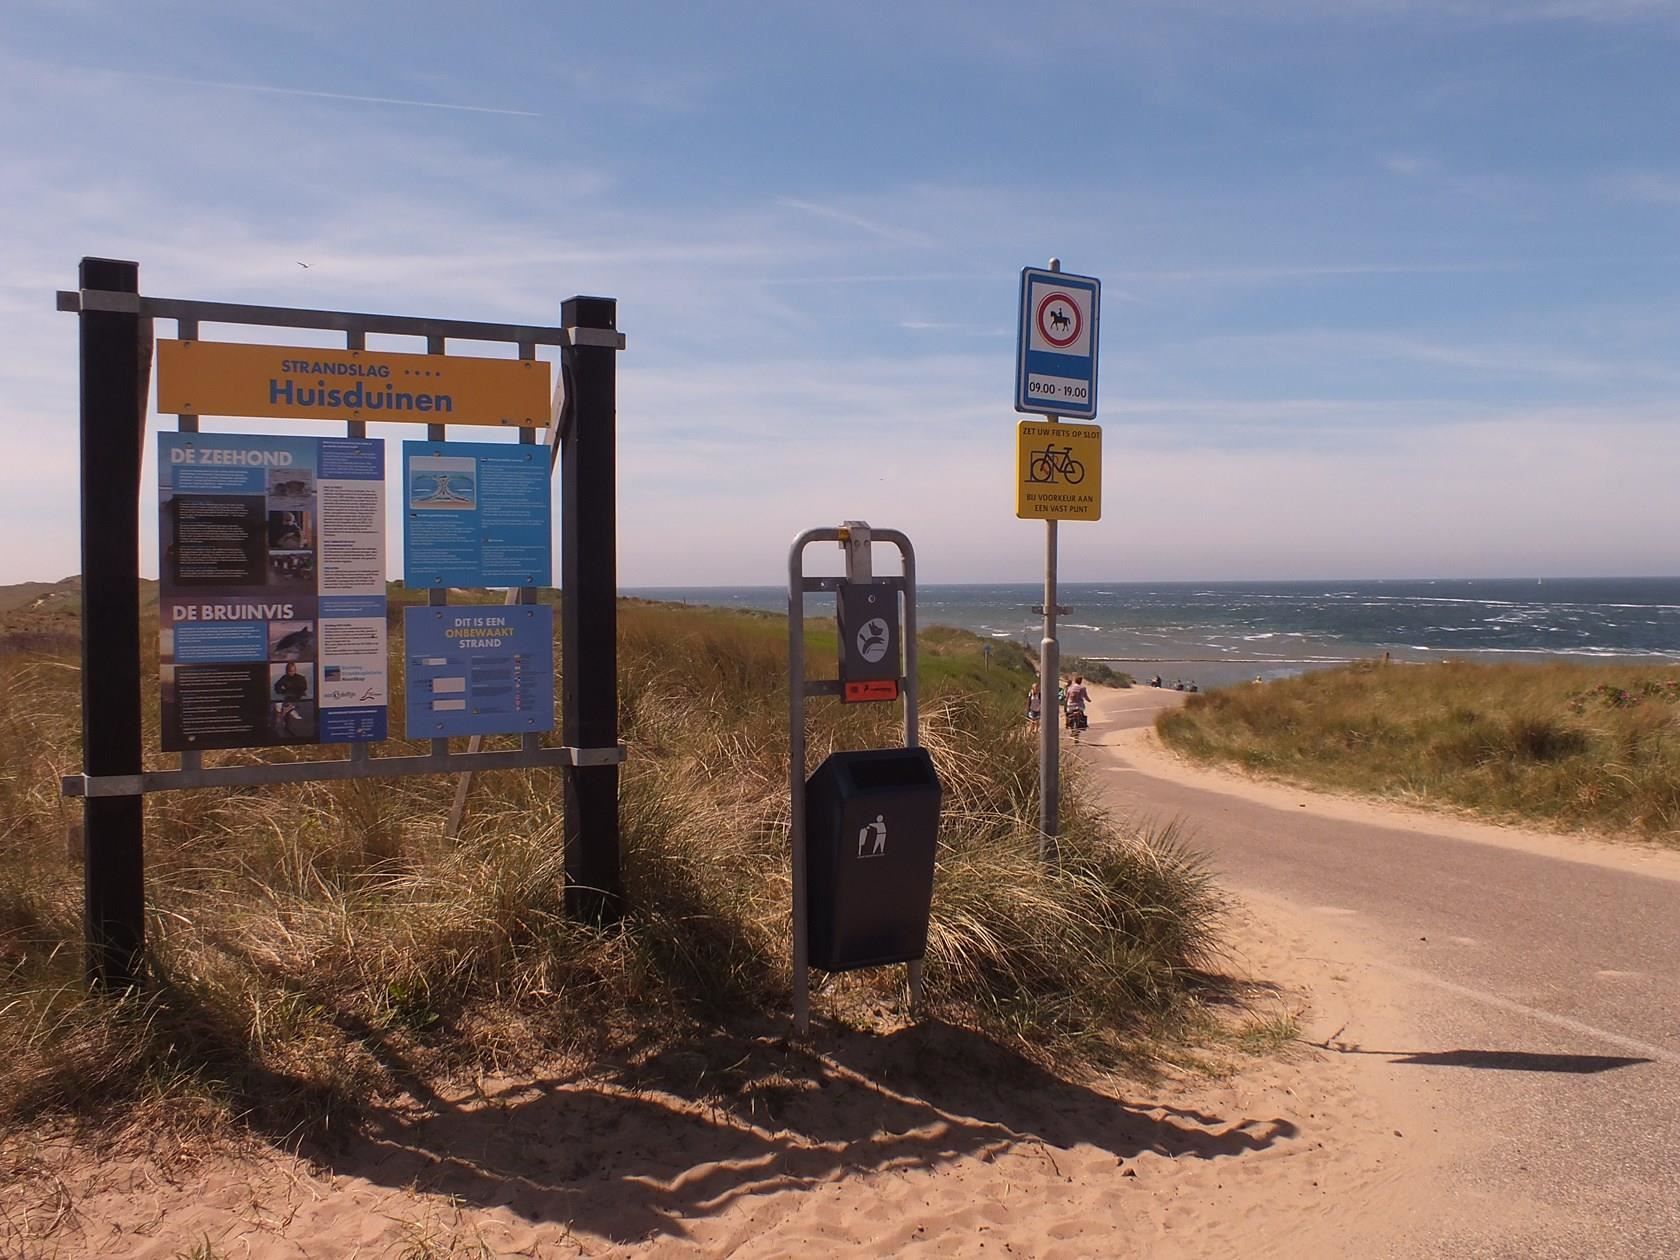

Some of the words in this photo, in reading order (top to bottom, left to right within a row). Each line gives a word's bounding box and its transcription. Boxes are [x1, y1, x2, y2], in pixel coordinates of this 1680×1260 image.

[281, 360, 390, 378] STRANDSLAG
[269, 379, 452, 412] Huisduinen
[1029, 381, 1056, 395] 09.00
[1063, 385, 1087, 398] 19.00
[1023, 427, 1037, 435] ZET
[1039, 428, 1050, 436] UW
[1052, 429, 1070, 437] FIETS
[1072, 430, 1082, 438] OP
[1084, 431, 1100, 439] SLOT
[171, 448, 195, 464] DE
[200, 449, 292, 466] ZEEHOND
[1026, 493, 1036, 501] BIJ
[1038, 494, 1076, 502] VOORKEUR
[1034, 504, 1048, 512] EEN
[1050, 504, 1067, 512] VAST
[1069, 505, 1088, 513] PUNT
[172, 605, 197, 620] DE
[201, 604, 294, 620] BRUINVIS
[455, 617, 472, 627] DIT
[474, 617, 484, 627] IS
[486, 617, 505, 626] EEN
[446, 627, 514, 638] ONBEWAAKT
[459, 638, 502, 648] STRAND
